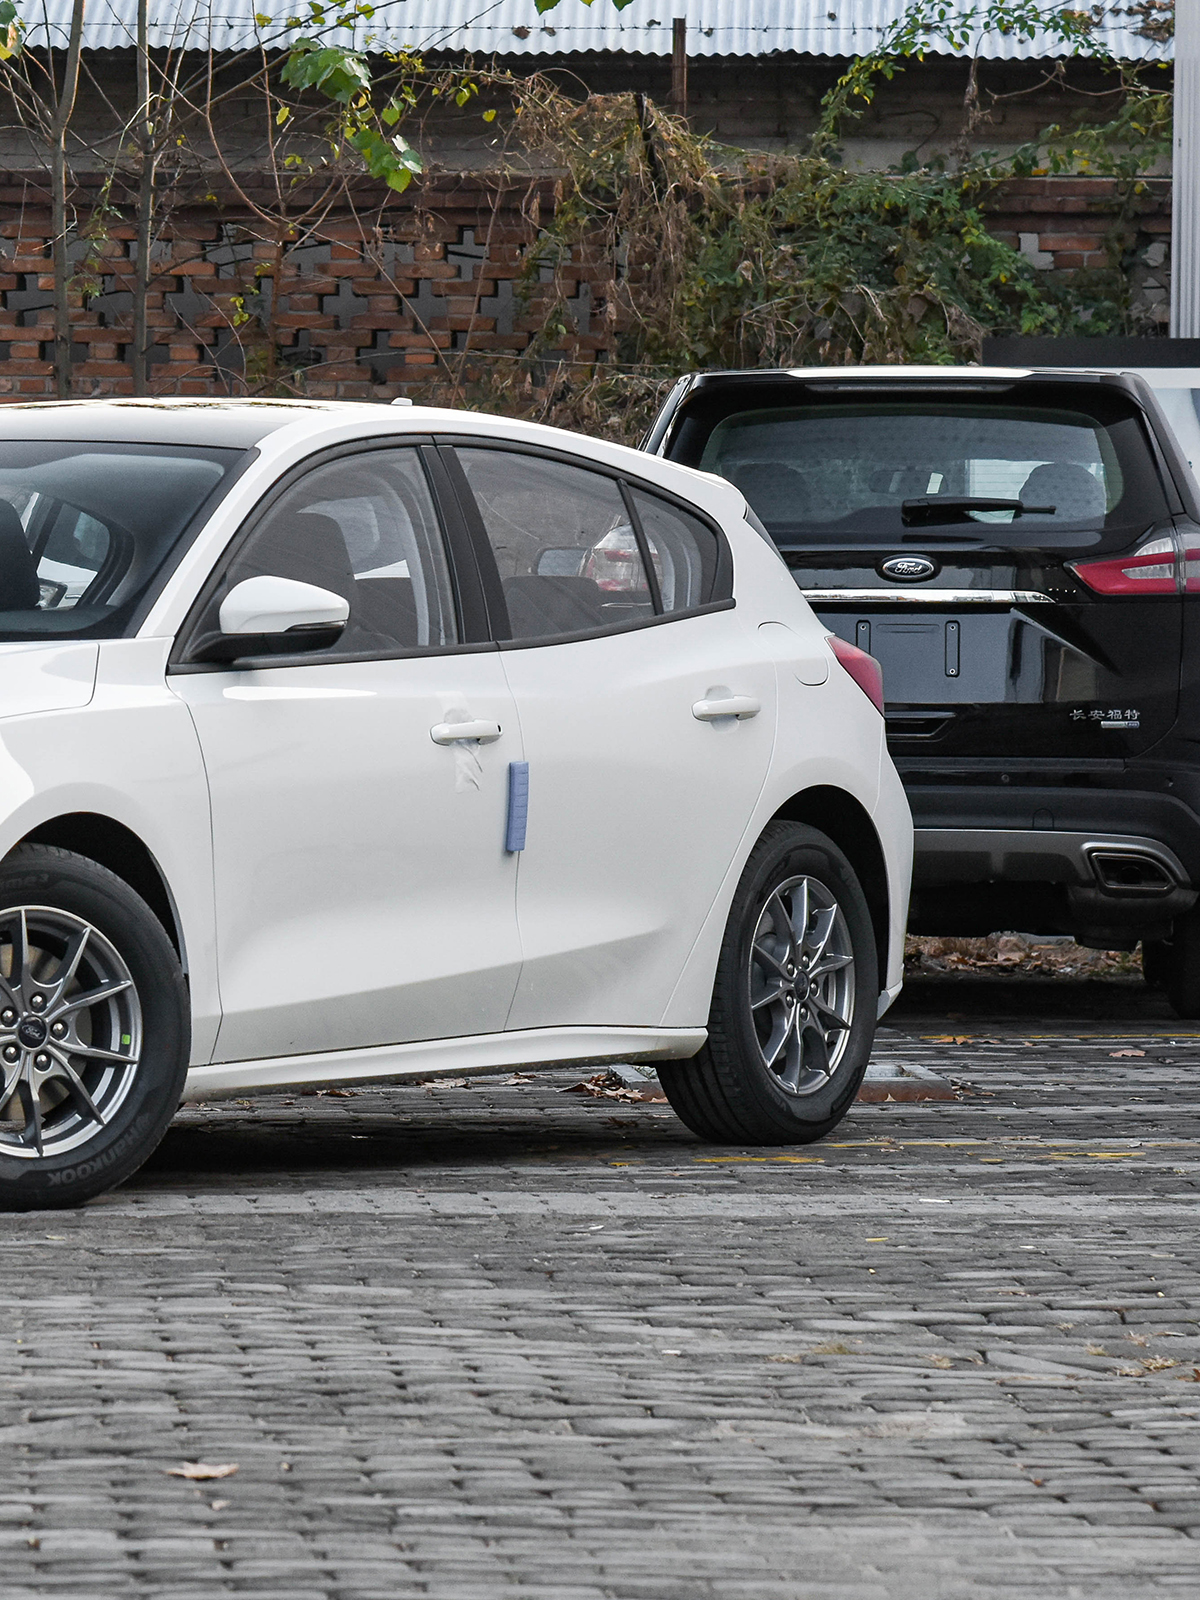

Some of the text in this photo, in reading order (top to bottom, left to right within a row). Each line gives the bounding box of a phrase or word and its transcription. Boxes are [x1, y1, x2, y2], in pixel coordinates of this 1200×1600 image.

[894, 562, 922, 574] Ford
[1069, 709, 1140, 720] 长安福特
